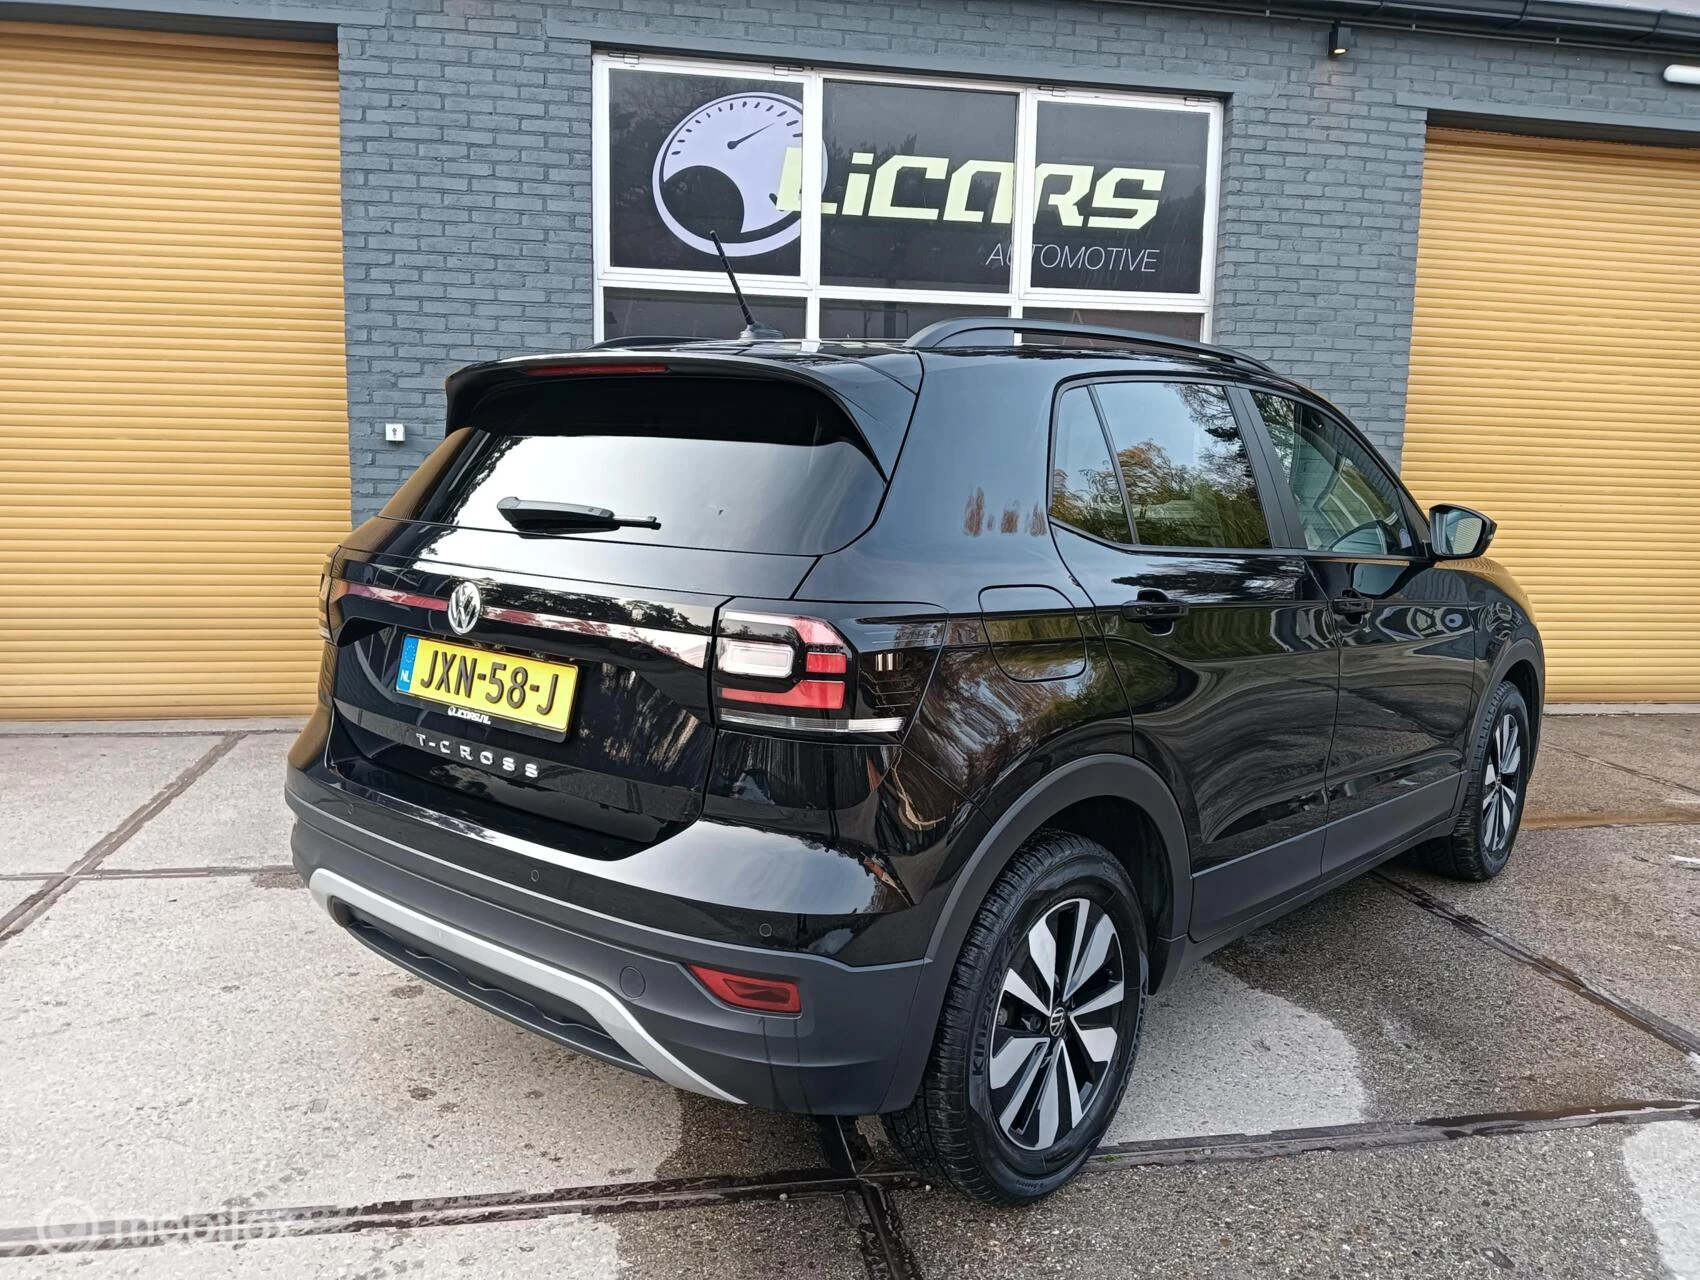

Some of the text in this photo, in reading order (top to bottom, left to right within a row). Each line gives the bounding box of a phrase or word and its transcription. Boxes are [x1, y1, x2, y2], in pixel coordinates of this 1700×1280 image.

[400, 669, 411, 684] NL
[420, 650, 559, 716] JXN-58-J
[415, 732, 539, 777] T-CROSS
